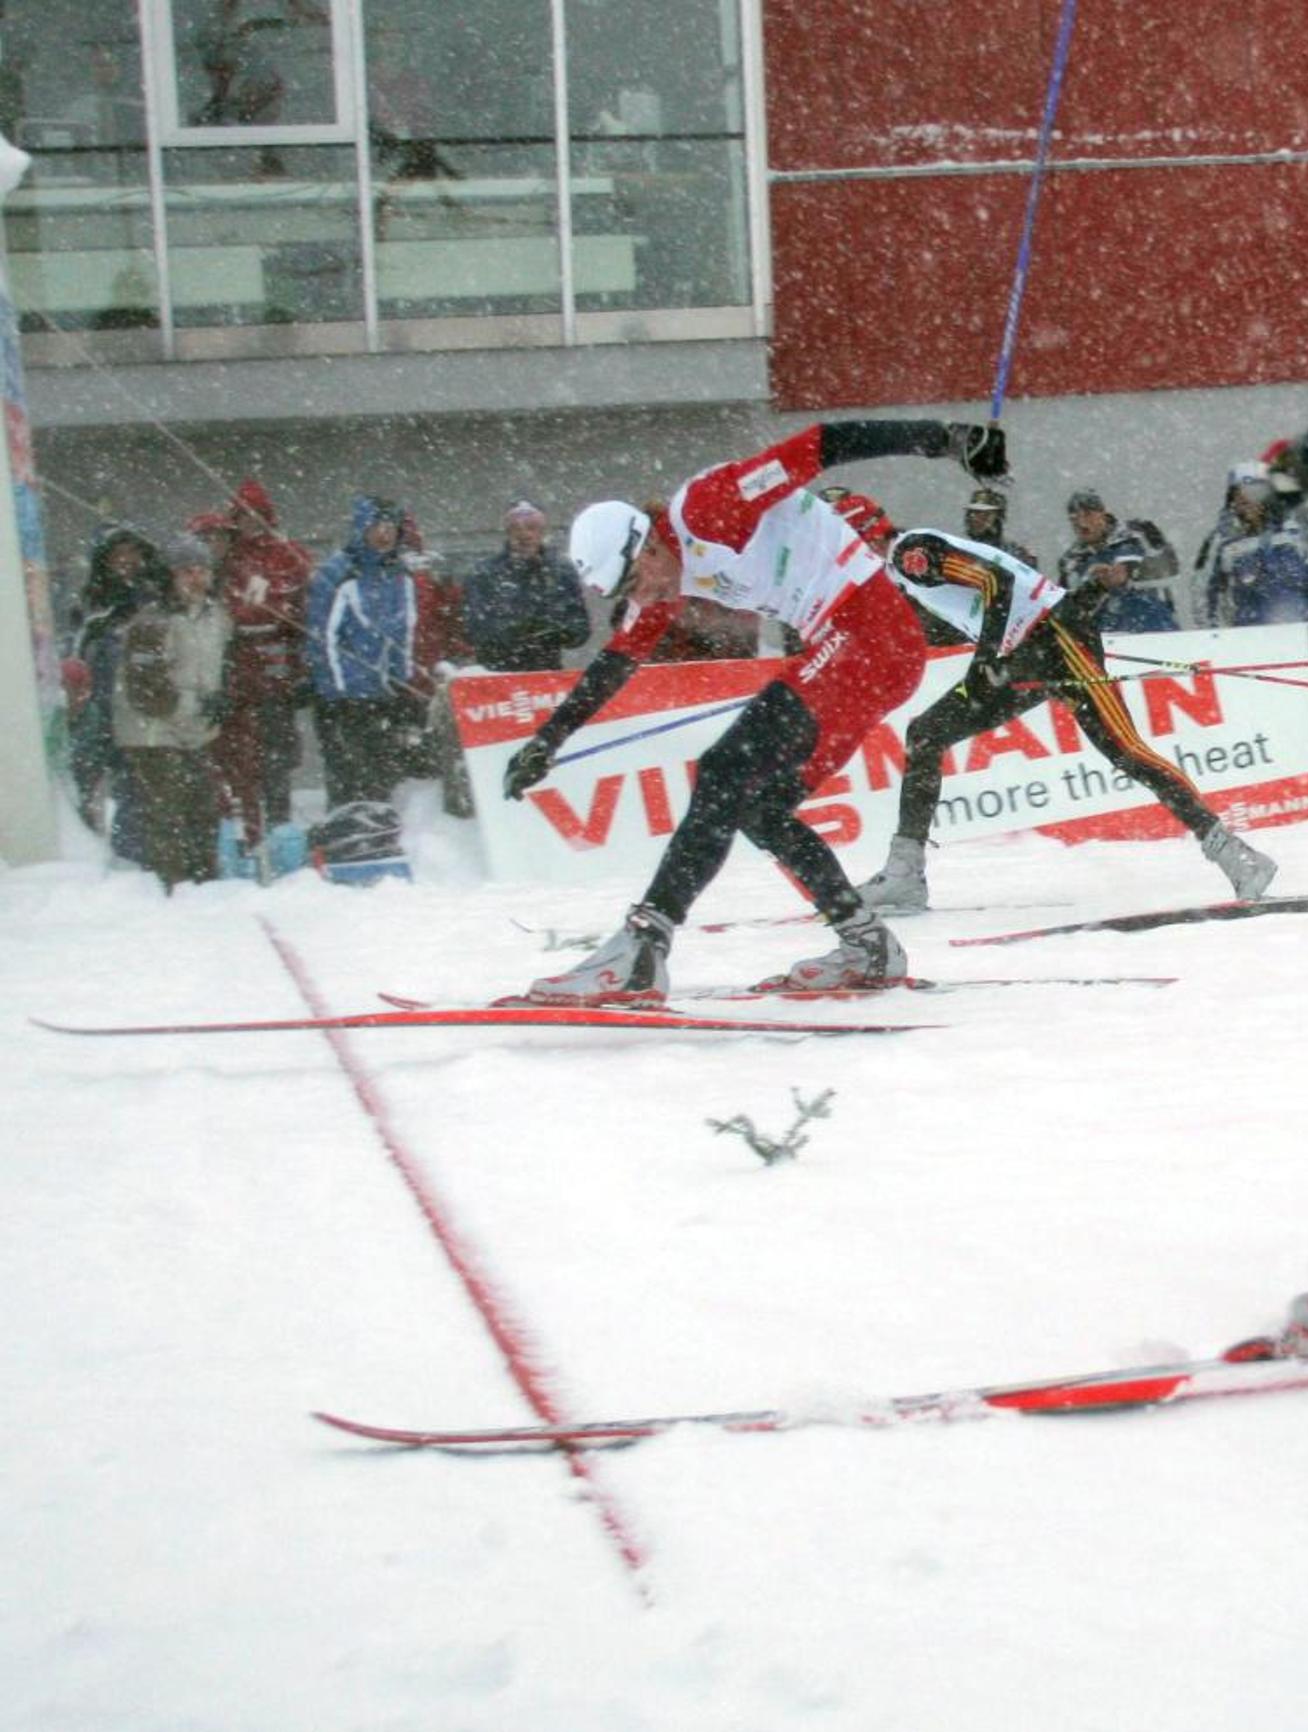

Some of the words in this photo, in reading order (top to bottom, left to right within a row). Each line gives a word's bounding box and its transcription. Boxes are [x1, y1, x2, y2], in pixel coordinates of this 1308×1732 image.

[932, 779, 1049, 828] more
[1061, 762, 1134, 802] tha
[1173, 733, 1275, 779] heat
